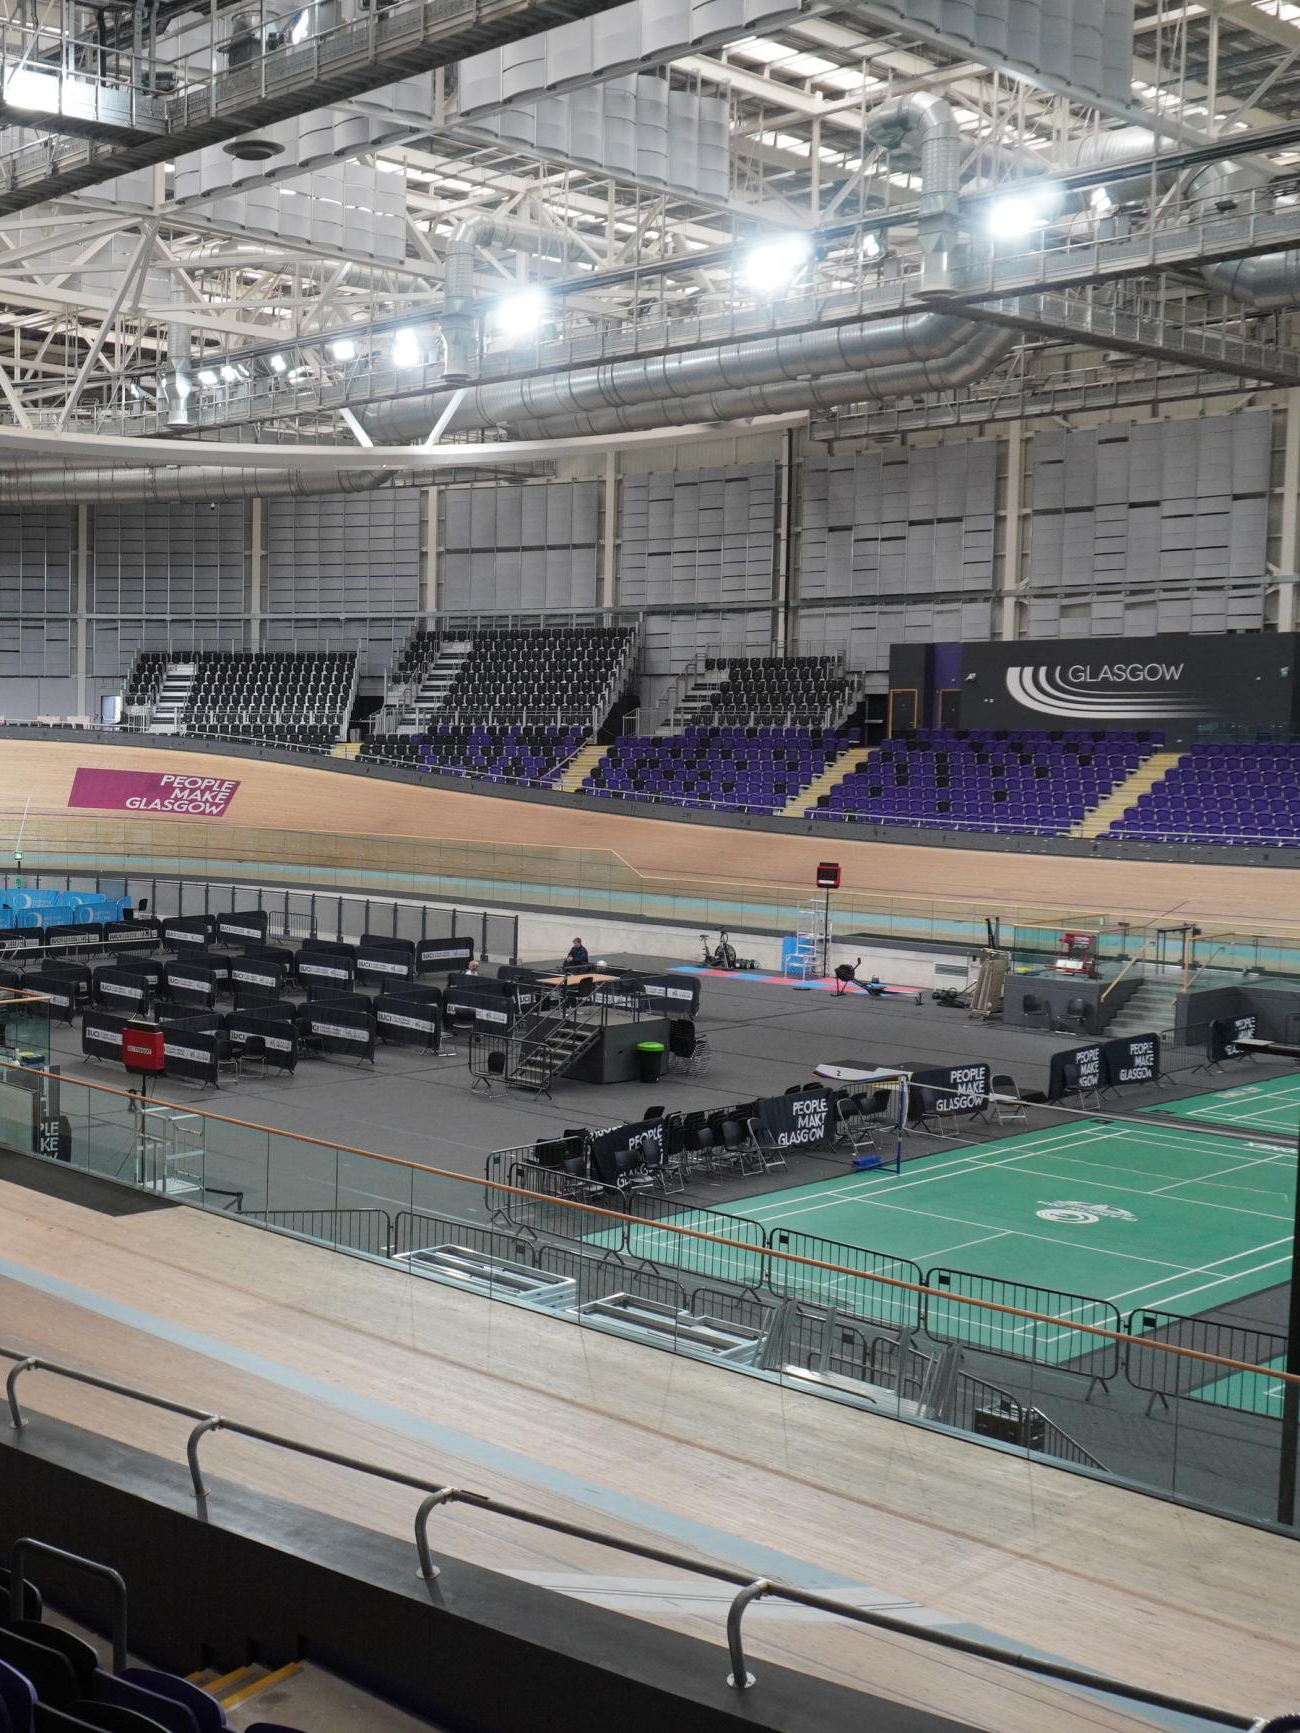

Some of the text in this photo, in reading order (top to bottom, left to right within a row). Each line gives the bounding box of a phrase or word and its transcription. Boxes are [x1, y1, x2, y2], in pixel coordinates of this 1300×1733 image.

[1068, 663, 1185, 682] GLASGOW
[160, 775, 236, 792] PEOPLE
[171, 788, 229, 804] MAKE
[125, 797, 225, 815] GLASGOW
[1076, 1048, 1099, 1064] PEOPLE
[1130, 1042, 1154, 1055] PEOPLE
[1080, 1061, 1099, 1075] MAKE
[1134, 1054, 1154, 1067] MAKE
[951, 1067, 985, 1083] PEOPLE
[957, 1080, 984, 1095] MAKE
[793, 1098, 828, 1116] PEOPLE
[936, 1095, 983, 1112] GLASGOW
